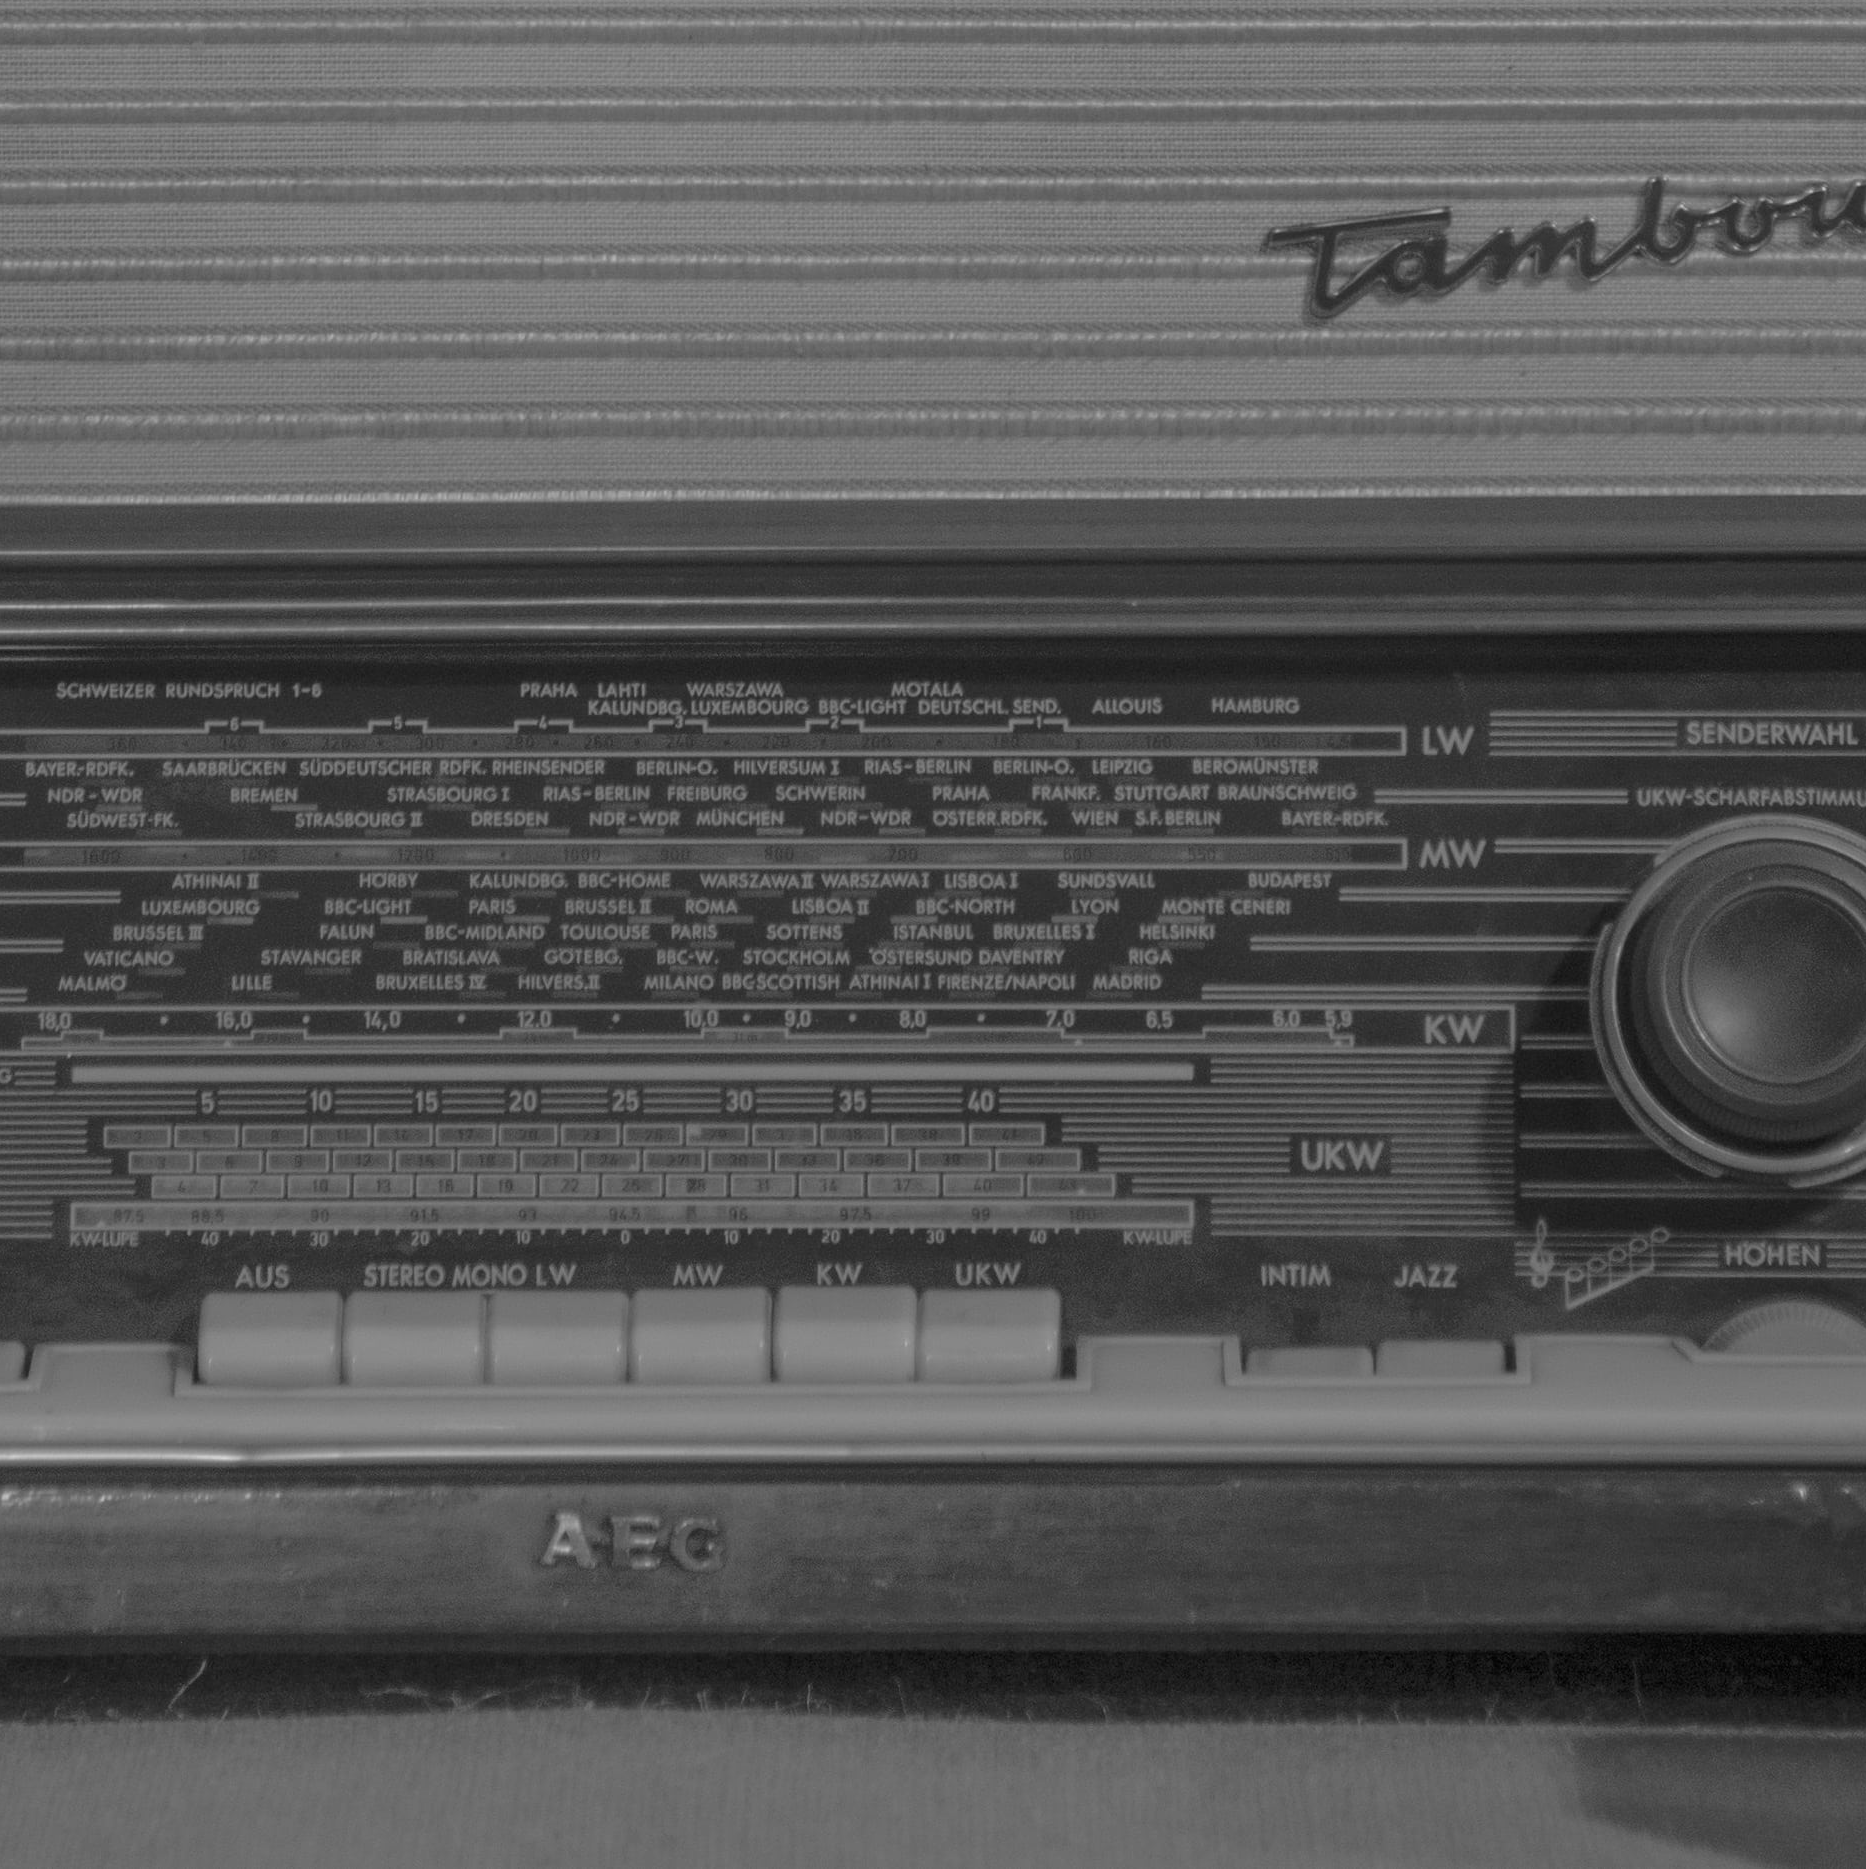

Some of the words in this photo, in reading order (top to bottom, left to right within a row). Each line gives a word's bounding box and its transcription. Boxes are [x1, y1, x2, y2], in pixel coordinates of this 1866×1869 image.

[56, 683, 156, 699] SCHWEIZER
[165, 683, 280, 699] RUNDSPRUCH
[520, 683, 578, 698] PRAHA
[598, 683, 646, 698] LAHTI
[687, 683, 784, 698] WARSZAWA
[892, 682, 964, 698] MOTALA
[588, 699, 687, 716] KALUNDBG.
[691, 699, 809, 715] LUXEMBOURG
[1092, 699, 1163, 714] ALLOUIS
[1212, 698, 1300, 714] HAMBURG
[1422, 726, 1474, 756] LW
[1686, 721, 1859, 747] SENDERWAHL
[162, 758, 287, 777] SAARBRÜCKEN
[299, 758, 431, 777] SÜDDEUTSCHER
[492, 759, 605, 775] RHEINSENDER
[734, 759, 825, 775] HILVERSUM
[864, 758, 971, 774] RIAS-BERLIN
[1092, 758, 1153, 775] LEIPZIG
[1193, 756, 1318, 775] BEROMÜNSTER
[231, 788, 298, 804] BREMEN
[387, 785, 498, 803] STRASBOURG
[543, 784, 650, 802] RIAS-BERLIN
[668, 785, 748, 802] FREIBURG
[775, 784, 865, 802] SCHWERIN
[933, 785, 990, 801] PRAHA
[1114, 784, 1211, 801] STUTTGART
[1218, 784, 1357, 801] BRAUNSCHWEIG
[295, 811, 406, 828] STRASBOURG
[471, 809, 549, 826] DRESDEN
[696, 807, 784, 826] MÜNCHEN
[1071, 810, 1119, 826] WIEN
[1420, 838, 1486, 870] MW
[172, 874, 242, 890] ATHINAI
[700, 872, 800, 889] WARSZAWA
[820, 872, 918, 889] WARSZAWA
[944, 873, 1007, 890] LISBOA
[1058, 872, 1155, 889] SUNDSVALL
[1248, 872, 1332, 889] BUDAPEST
[141, 899, 261, 917] LUXEMBOURG
[469, 898, 517, 916] PARIS
[565, 898, 637, 916] BRUSSEL
[685, 898, 738, 915] ROMA
[792, 898, 854, 915] LISBOA
[1071, 898, 1119, 916] LYON
[1161, 898, 1225, 915] MONTE
[1231, 898, 1291, 915] CENERI
[113, 924, 185, 941] BRUSSEL
[320, 924, 374, 941] FALUN
[561, 923, 652, 941] TOULOUSE
[671, 923, 717, 941] PARIS
[766, 923, 843, 941] SOTTENS
[893, 923, 973, 940] ISTANBUL
[993, 923, 1083, 941] BRUXELLES
[1139, 923, 1216, 940] HELSINKI
[83, 949, 174, 967] VATICANO
[261, 949, 362, 966] STAVANGER
[403, 949, 500, 966] BRATISLAVA
[743, 948, 850, 966] STOCKHOLM
[978, 948, 1065, 966] DAVENTRY
[1128, 948, 1173, 966] RIGA
[231, 974, 273, 991] LILLE
[375, 973, 469, 992] BRUXELLES
[644, 974, 714, 991] MILANO
[848, 973, 919, 991] ATHINAI
[938, 973, 1075, 991] FIRENZE/NAPOLI
[1092, 974, 1162, 991] MADRID
[38, 1011, 71, 1030] 18,0
[216, 1011, 252, 1030] 16,0
[364, 1011, 401, 1029] 14,0
[685, 1010, 719, 1028] 10,0
[785, 1010, 811, 1028] 9,0
[900, 1010, 927, 1028] 8,0
[1046, 1009, 1075, 1028] 7,0
[1146, 1010, 1173, 1029] 6,5
[1273, 1009, 1301, 1028] 6,0
[1325, 1009, 1353, 1028] 5,9
[1424, 1015, 1485, 1045] KW
[200, 1091, 215, 1114] 5
[309, 1090, 332, 1112] 10
[415, 1090, 438, 1112] 15
[509, 1090, 538, 1112] 20
[612, 1090, 639, 1111] 25
[726, 1090, 753, 1111] 30
[839, 1090, 867, 1111] 35
[968, 1090, 995, 1112] 40
[1301, 1139, 1383, 1172] UKW
[236, 1266, 290, 1288] AUS
[364, 1265, 444, 1288] STEREO
[452, 1265, 527, 1287] MONO
[536, 1264, 576, 1286] LW
[673, 1265, 722, 1286] MW
[817, 1264, 863, 1285] KW
[955, 1262, 1022, 1286] UKW
[1260, 1264, 1332, 1287] INTIM
[1394, 1264, 1458, 1288] JAZZ
[541, 1511, 725, 1573] AEG
